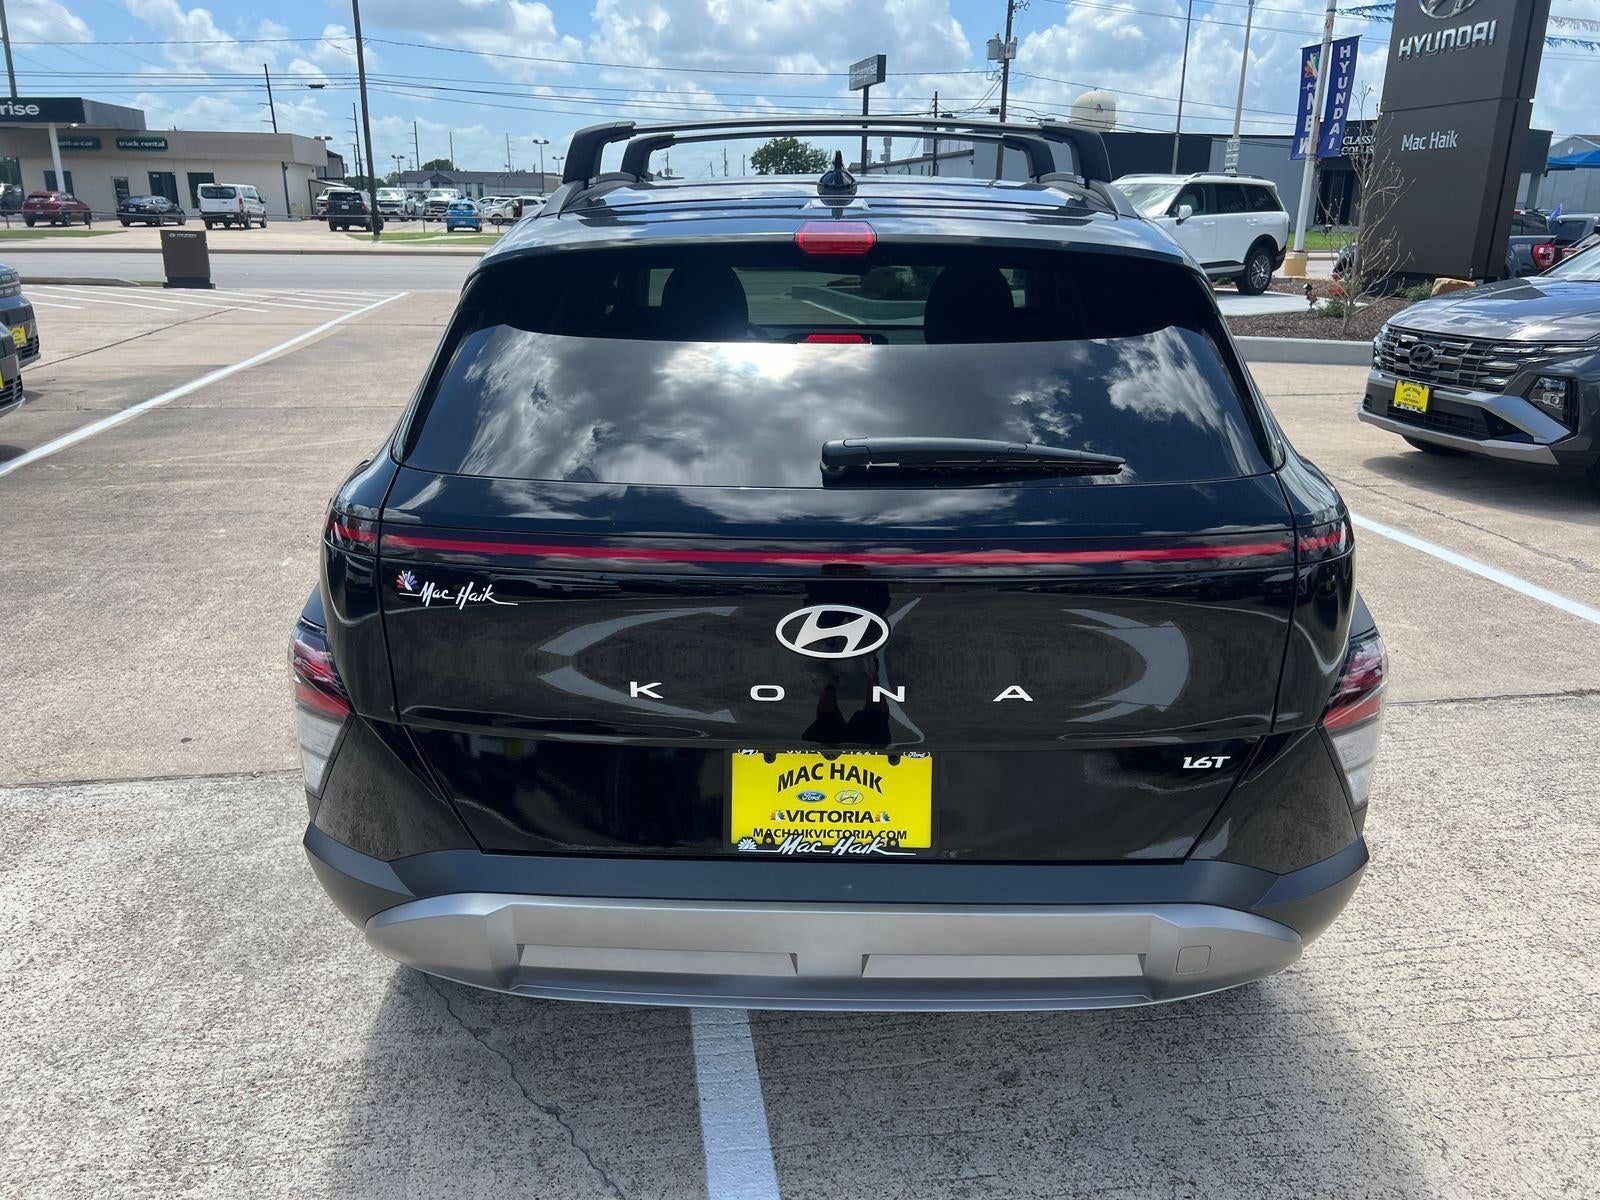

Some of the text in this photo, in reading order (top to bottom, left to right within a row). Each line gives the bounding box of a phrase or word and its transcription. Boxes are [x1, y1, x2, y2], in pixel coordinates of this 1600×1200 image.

[1398, 19, 1497, 59] HYUNDAI
[1327, 45, 1351, 150] HYUNDAI
[1401, 129, 1459, 152] Mac Haik
[420, 581, 502, 610] Mac Haik
[629, 681, 1034, 703] KONA
[777, 762, 883, 794] MAC HAIK
[801, 792, 822, 801] Ford
[785, 809, 875, 824] VICTORIA
[753, 828, 908, 840] MACHAIKVICTORIA.COM
[777, 834, 890, 856] Mac Haik
